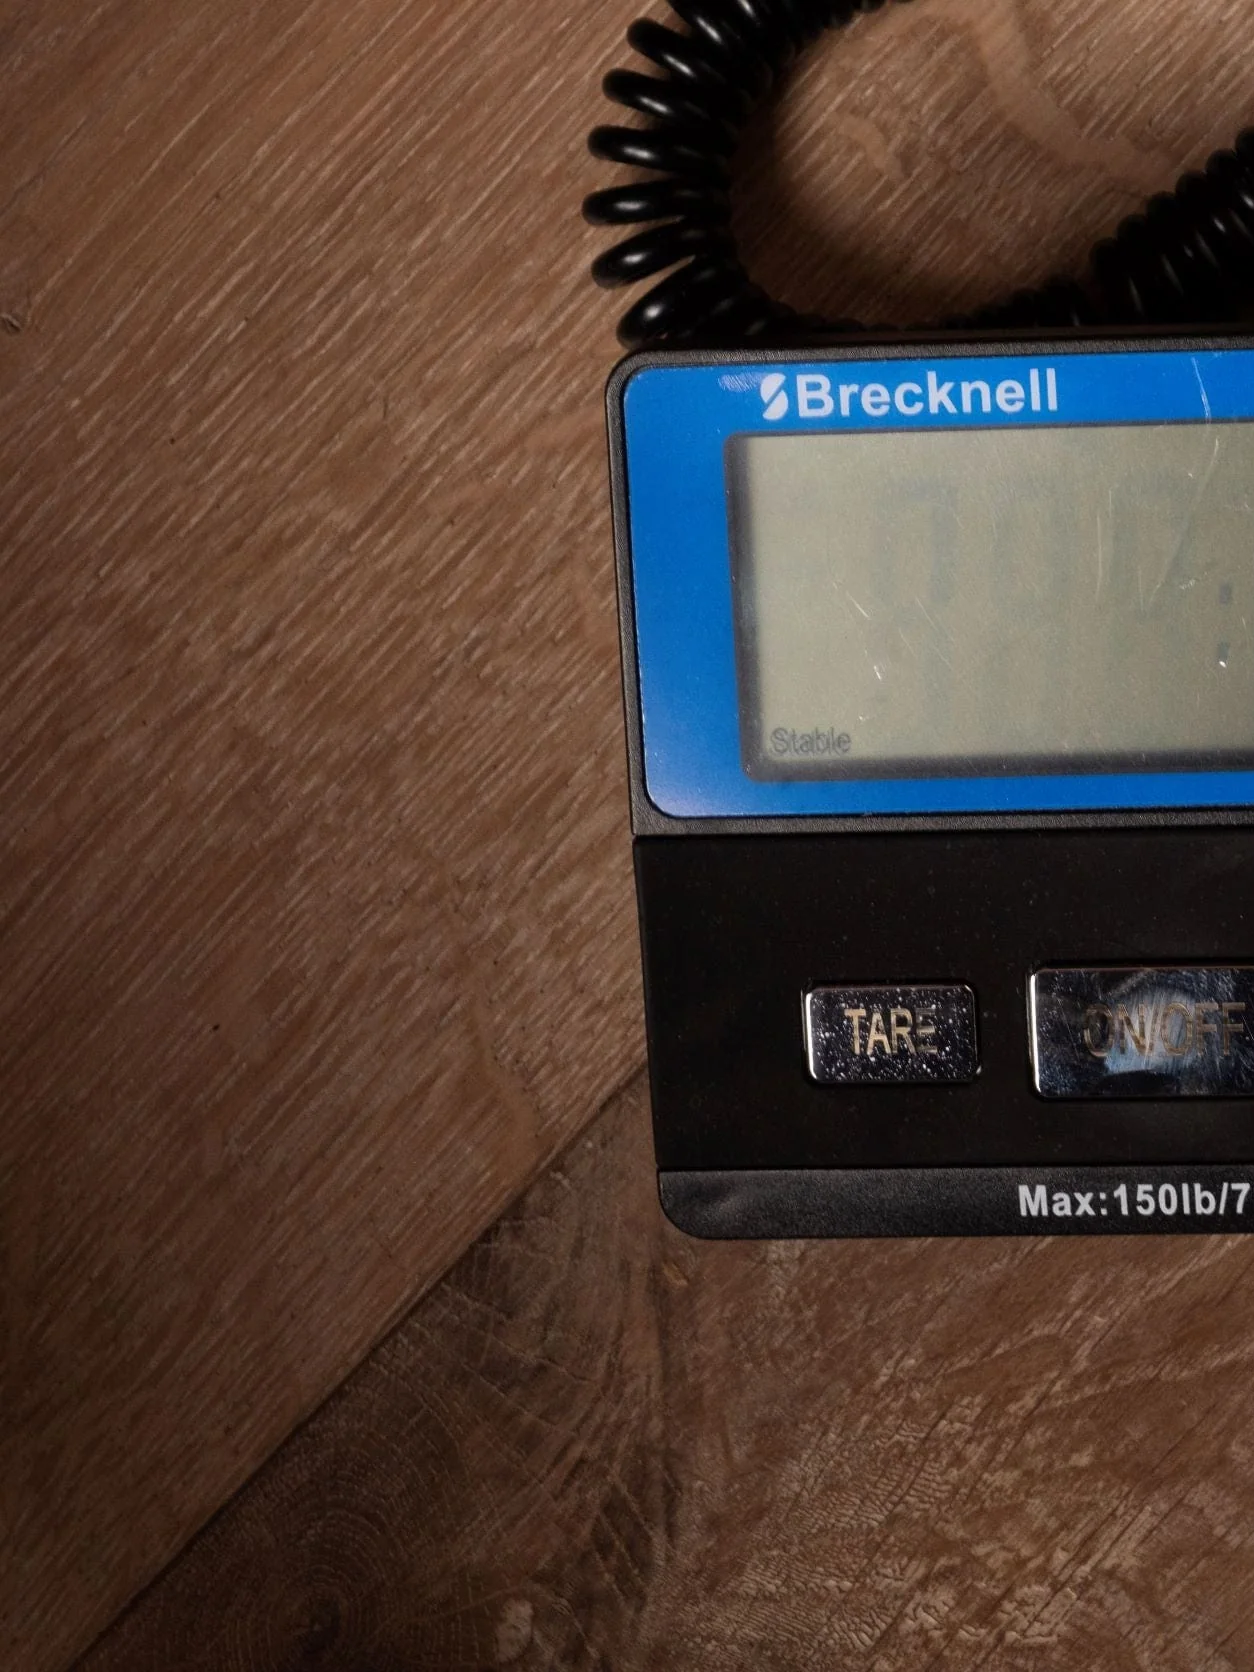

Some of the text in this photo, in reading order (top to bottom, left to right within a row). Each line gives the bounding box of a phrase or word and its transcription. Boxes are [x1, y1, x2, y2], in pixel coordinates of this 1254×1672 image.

[796, 367, 1058, 418] Brecknell
[770, 726, 851, 755] Stable
[844, 1008, 938, 1056] TARE
[1083, 1001, 1246, 1058] ON/OFF
